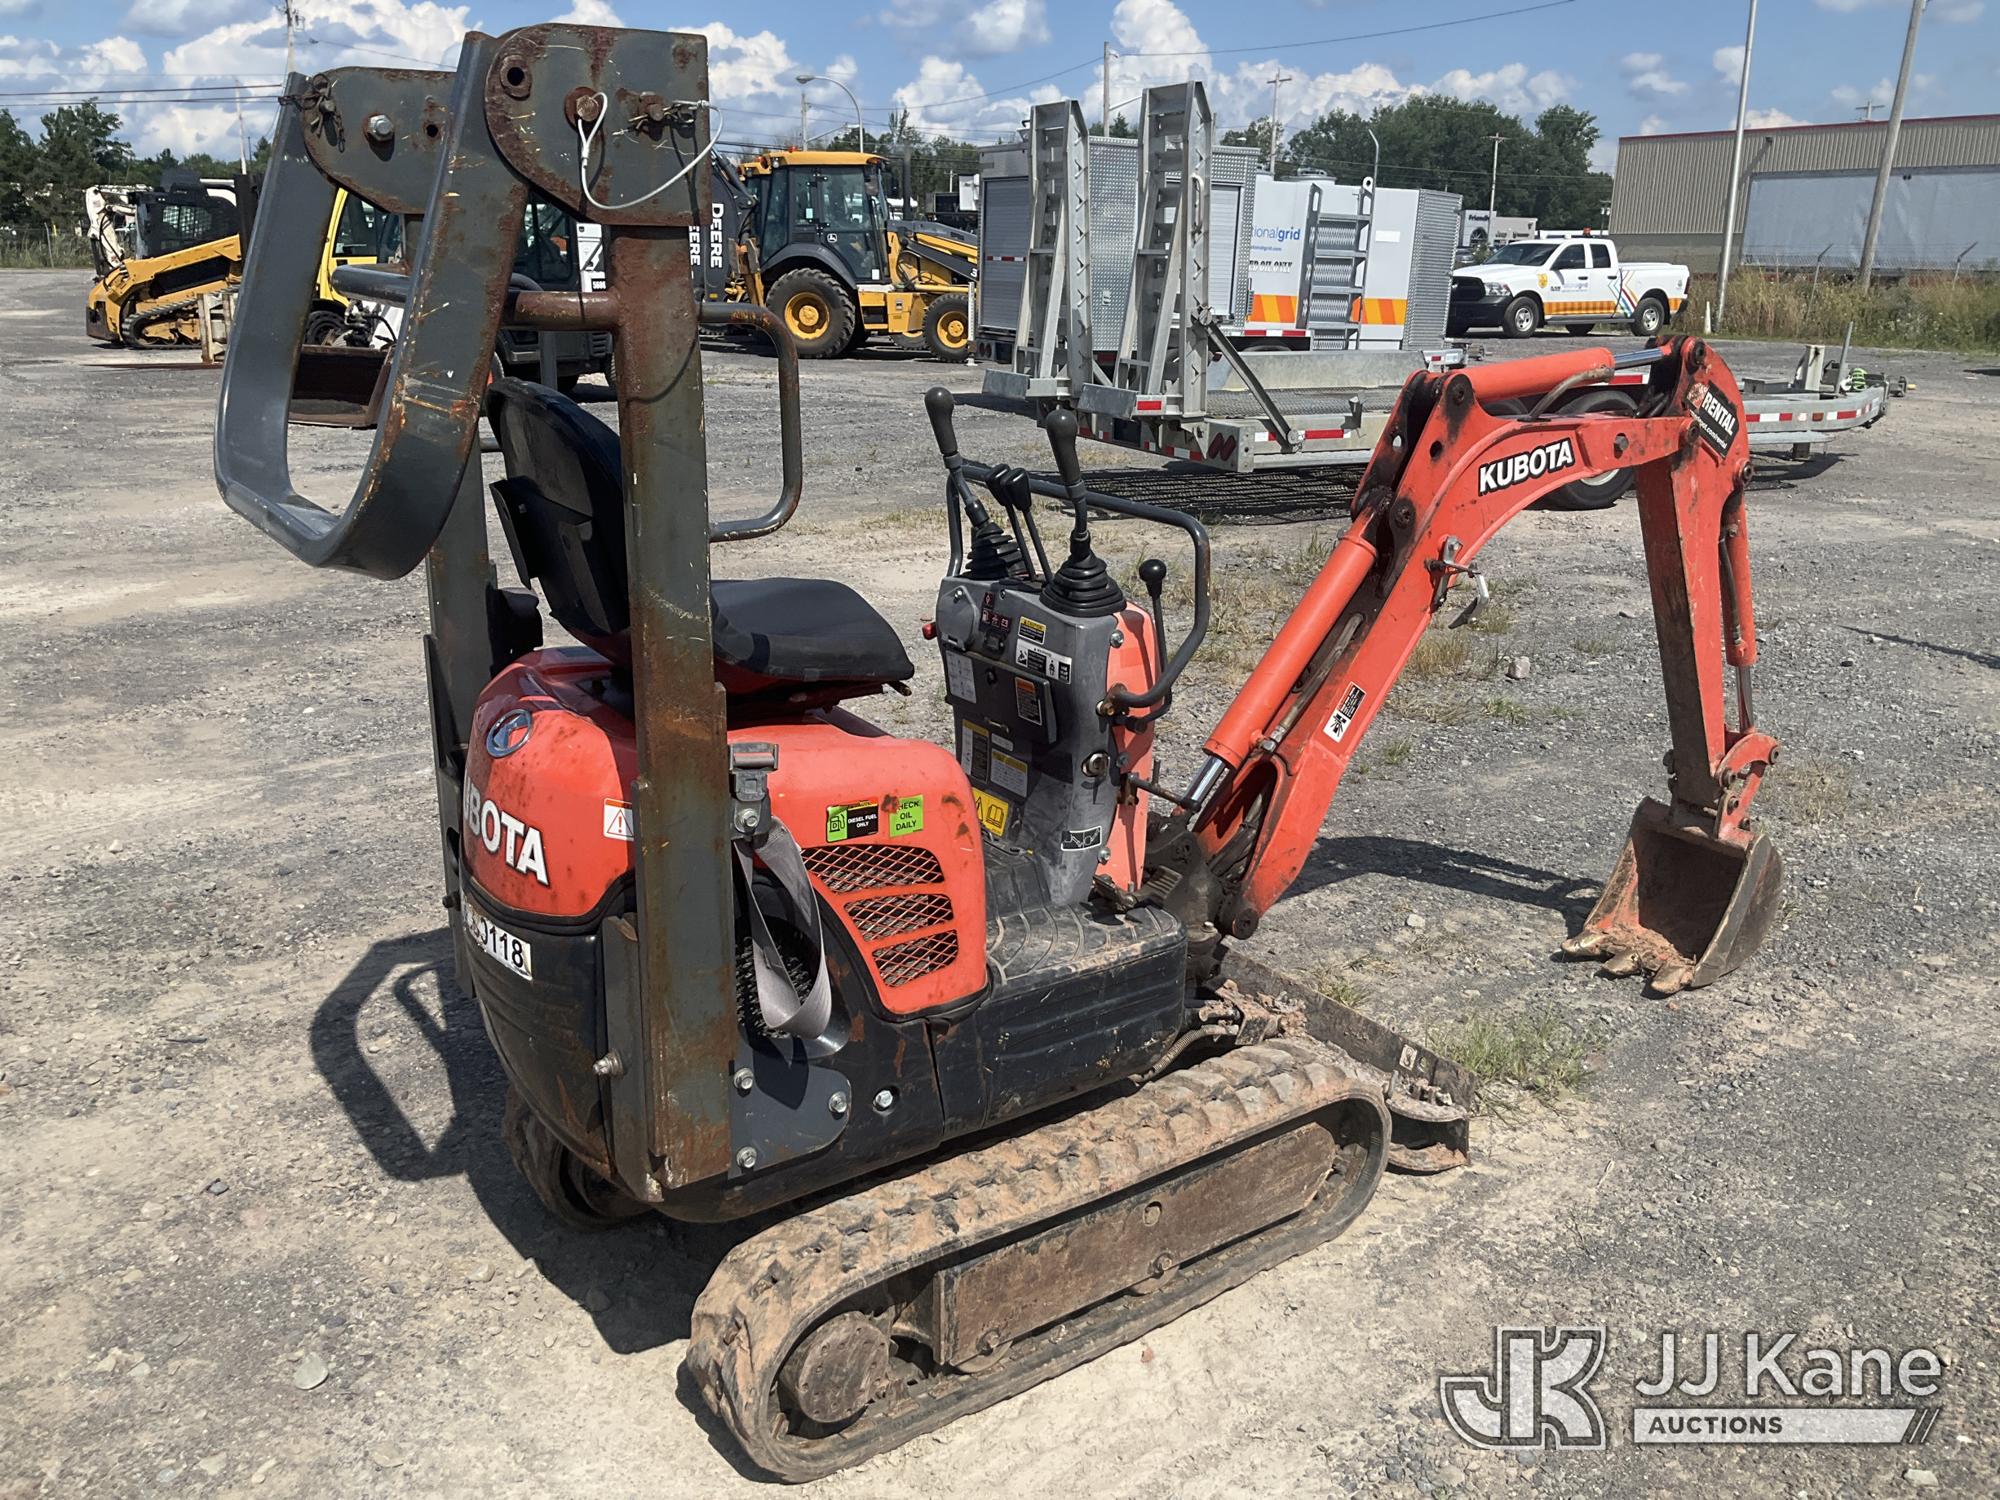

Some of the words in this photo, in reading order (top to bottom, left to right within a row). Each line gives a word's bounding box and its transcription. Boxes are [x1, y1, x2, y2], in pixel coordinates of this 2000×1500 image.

[689, 225, 701, 266] EERE
[710, 203, 724, 268] DEERE
[1253, 227, 1301, 242] ionalgrid
[1701, 391, 1736, 436] RENTAL
[1479, 440, 1573, 493] KUBOTA
[900, 800, 920, 810] HECK
[900, 812, 913, 820] OIL
[464, 776, 549, 886] UBOTA
[847, 816, 865, 824] DIESEL
[895, 820, 917, 831] DAILY
